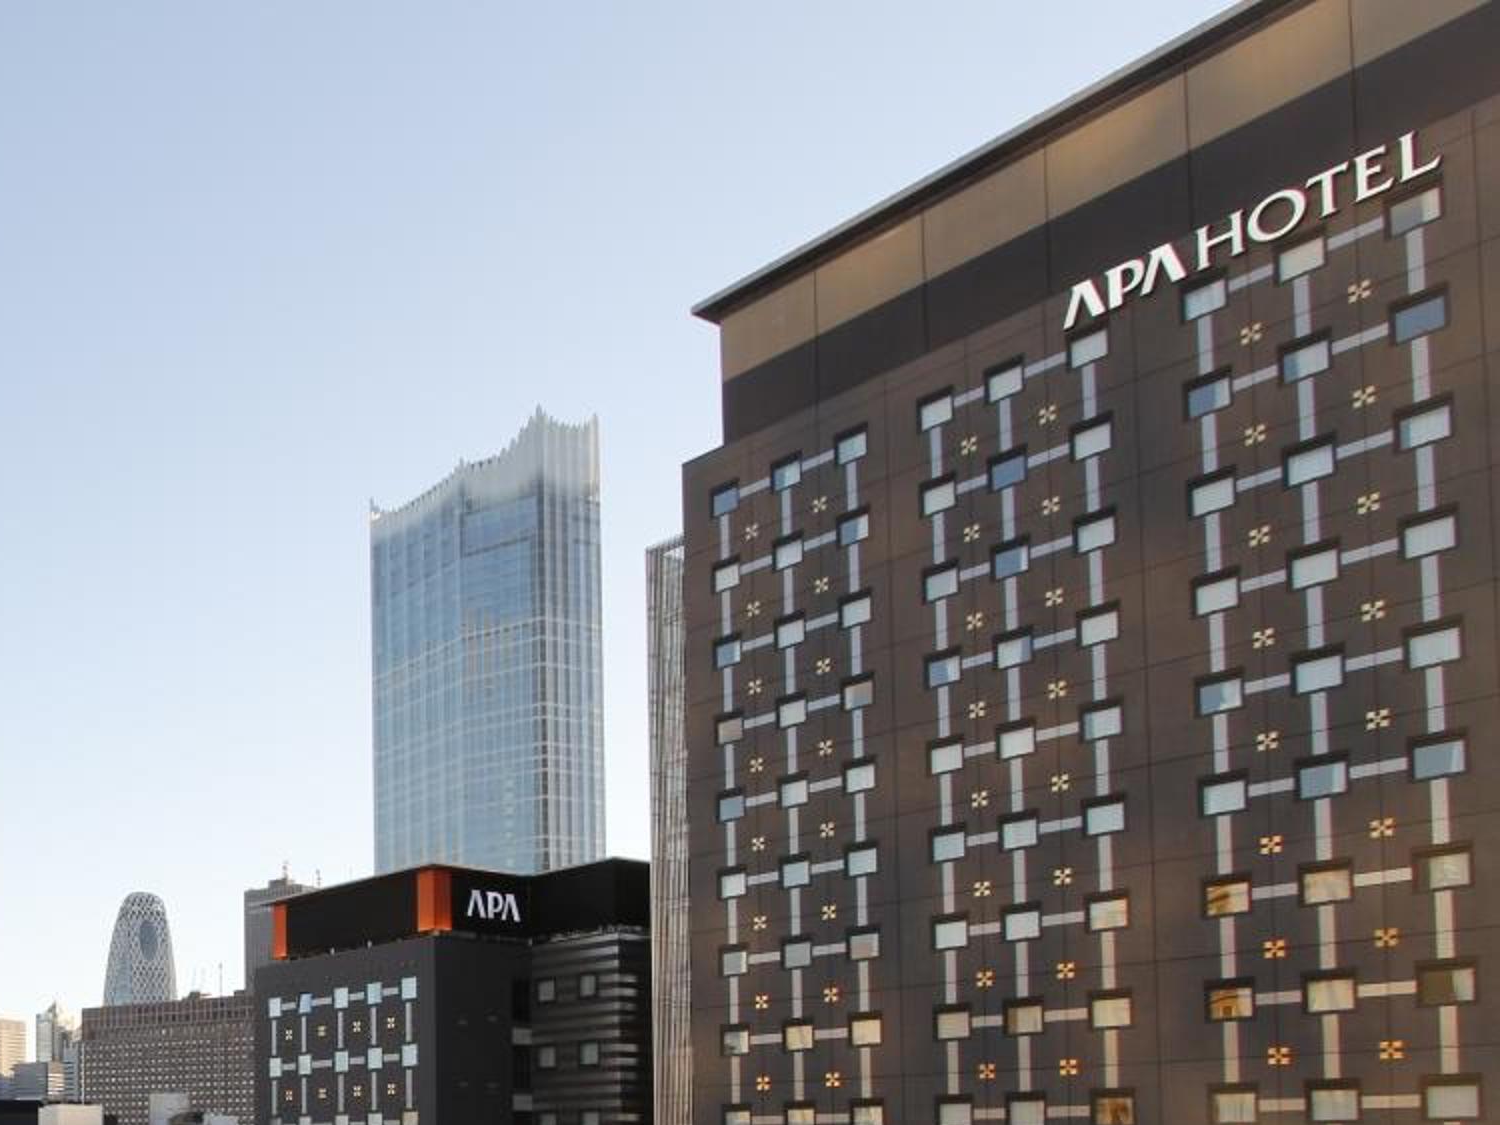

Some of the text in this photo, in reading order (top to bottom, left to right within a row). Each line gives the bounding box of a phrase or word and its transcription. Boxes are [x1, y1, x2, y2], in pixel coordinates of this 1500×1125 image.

[1063, 130, 1442, 330] APA HOTEL
[467, 889, 521, 922] APA
